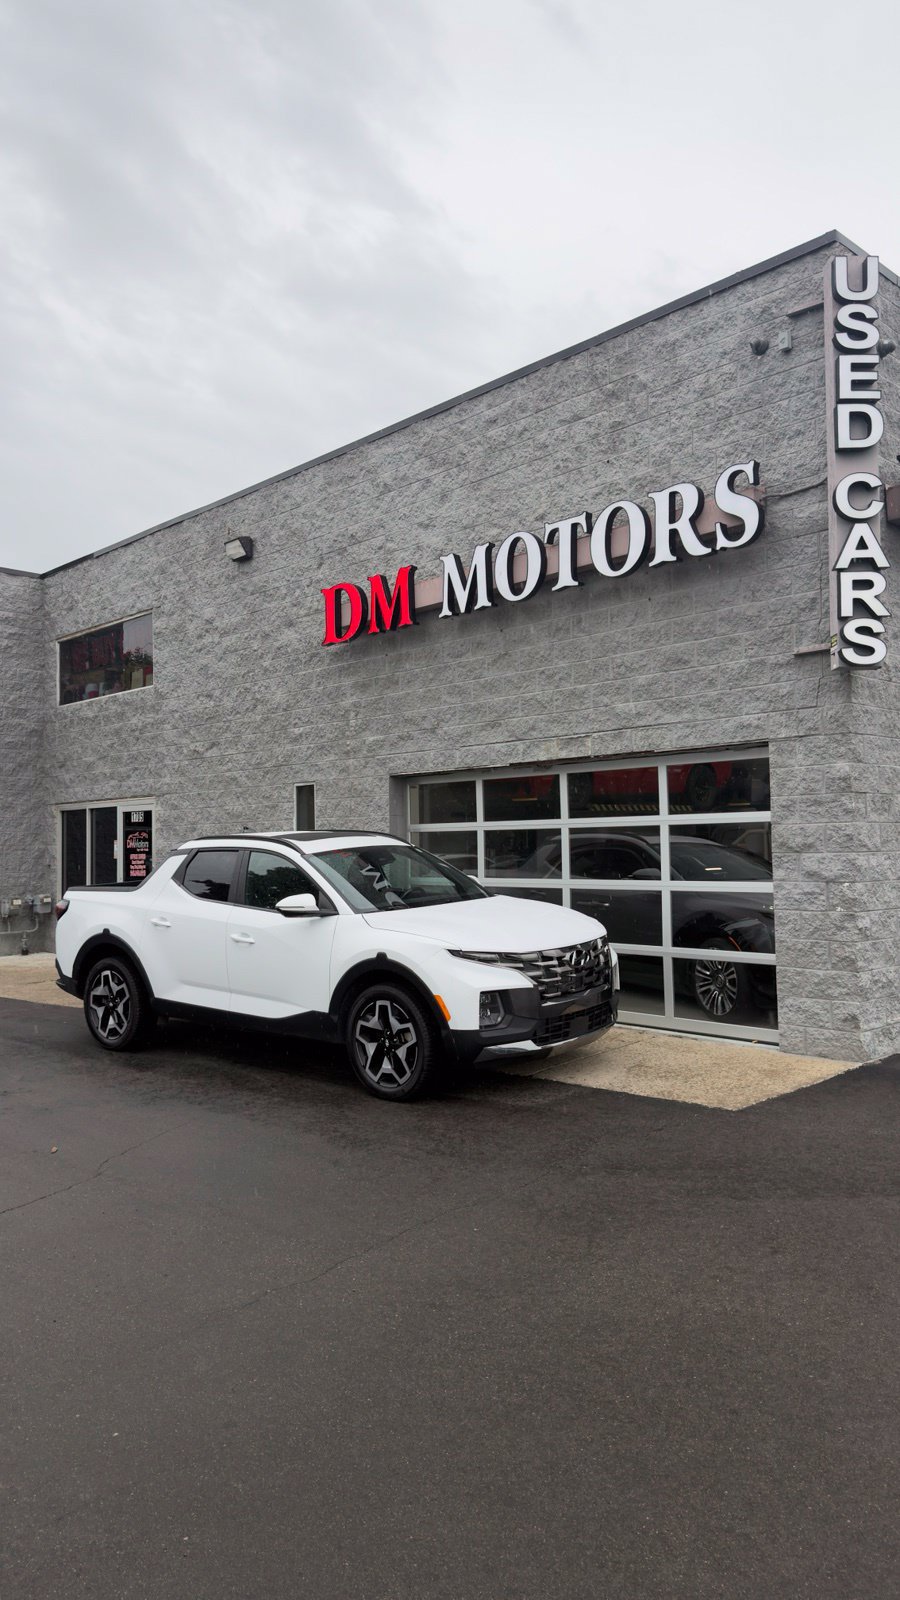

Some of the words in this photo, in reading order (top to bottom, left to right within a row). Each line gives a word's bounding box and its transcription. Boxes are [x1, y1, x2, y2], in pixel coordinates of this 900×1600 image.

[832, 255, 884, 450] USED
[321, 565, 417, 646] DM
[439, 460, 764, 618] MOTORS
[833, 472, 892, 666] CARS
